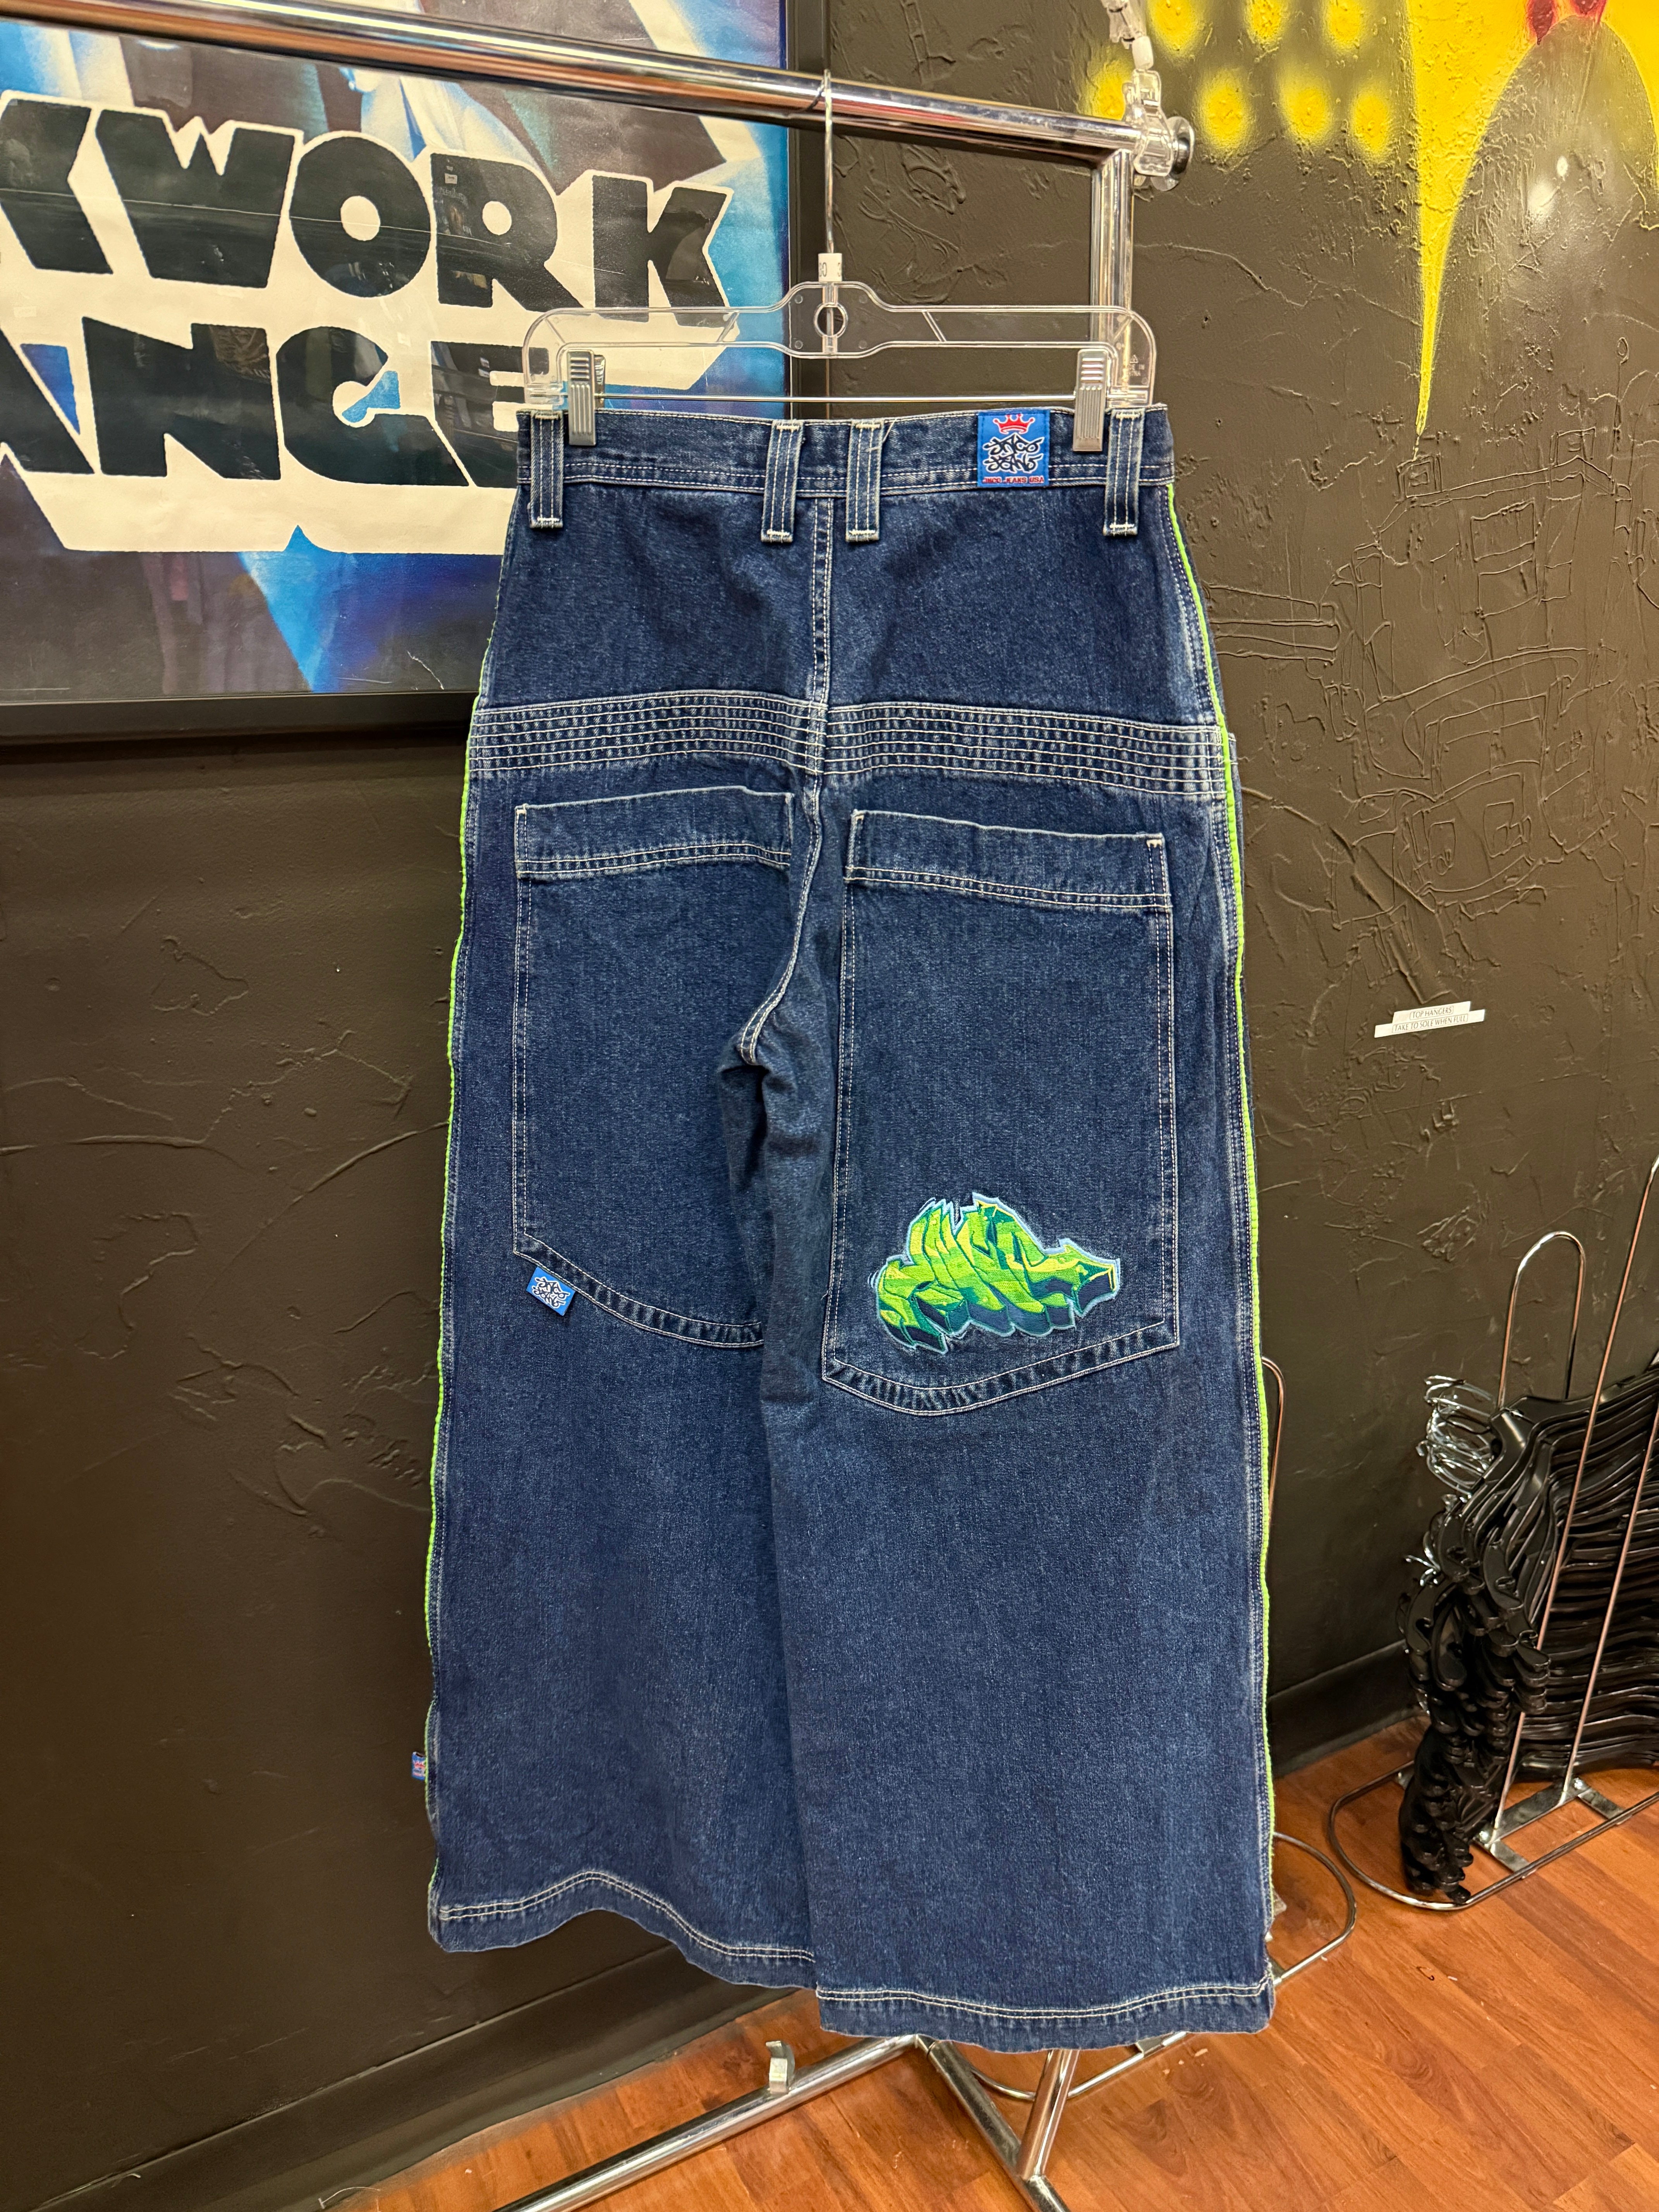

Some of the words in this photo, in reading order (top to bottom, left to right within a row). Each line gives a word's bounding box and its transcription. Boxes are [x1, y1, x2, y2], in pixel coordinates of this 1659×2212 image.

[1425, 1006, 1452, 1017] HANGERS
[1395, 1023, 1409, 1031] TAKE
[1419, 1019, 1434, 1028] SOLE
[1435, 1017, 1452, 1025] WHEN
[1453, 1015, 1466, 1023] FULL
